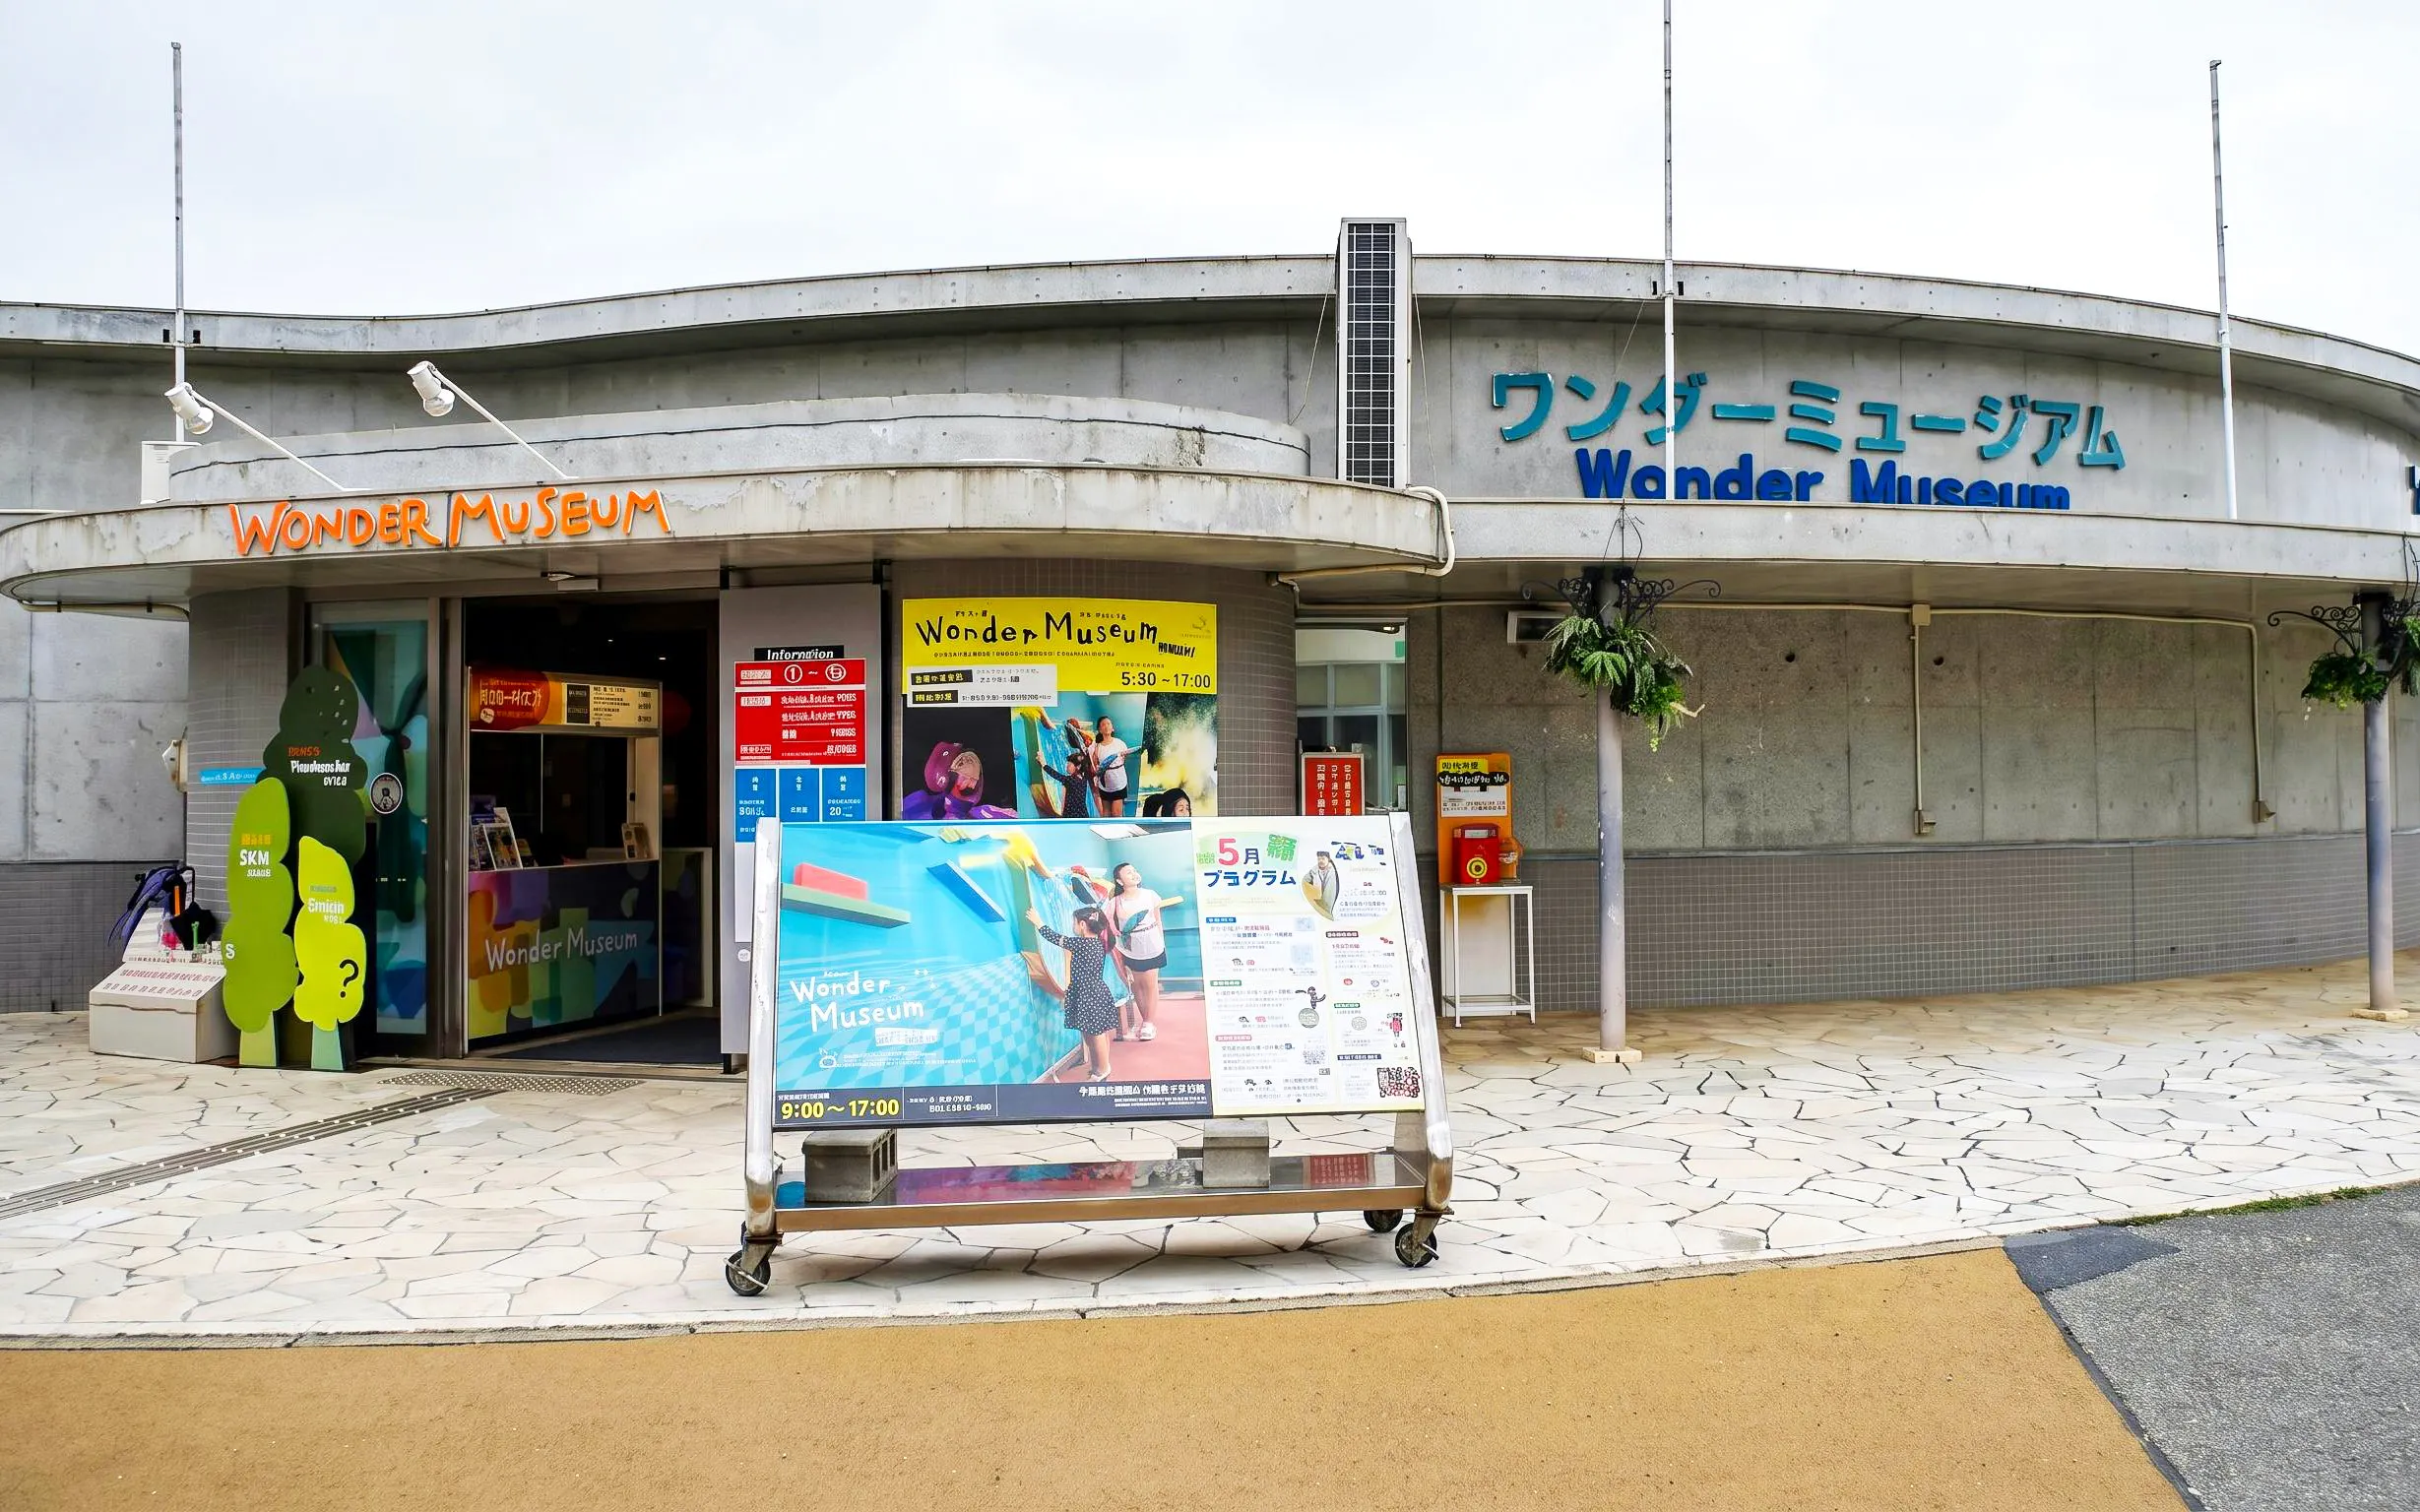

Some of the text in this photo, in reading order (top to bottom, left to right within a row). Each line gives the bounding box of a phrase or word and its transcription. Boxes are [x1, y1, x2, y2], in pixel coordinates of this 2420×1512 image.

[1493, 371, 2127, 471] ワンダーミュージアム
[1575, 447, 2070, 510] Wonder Museum
[228, 500, 443, 556] WONDER
[915, 610, 1158, 646] Wonder Museum
[1121, 671, 1156, 686] 5:30
[1174, 672, 1211, 688] 17:00
[1218, 838, 1260, 866] 5月
[485, 927, 638, 973] Wonder Museum
[790, 970, 891, 1002] Wonder
[810, 1000, 924, 1033] Museum
